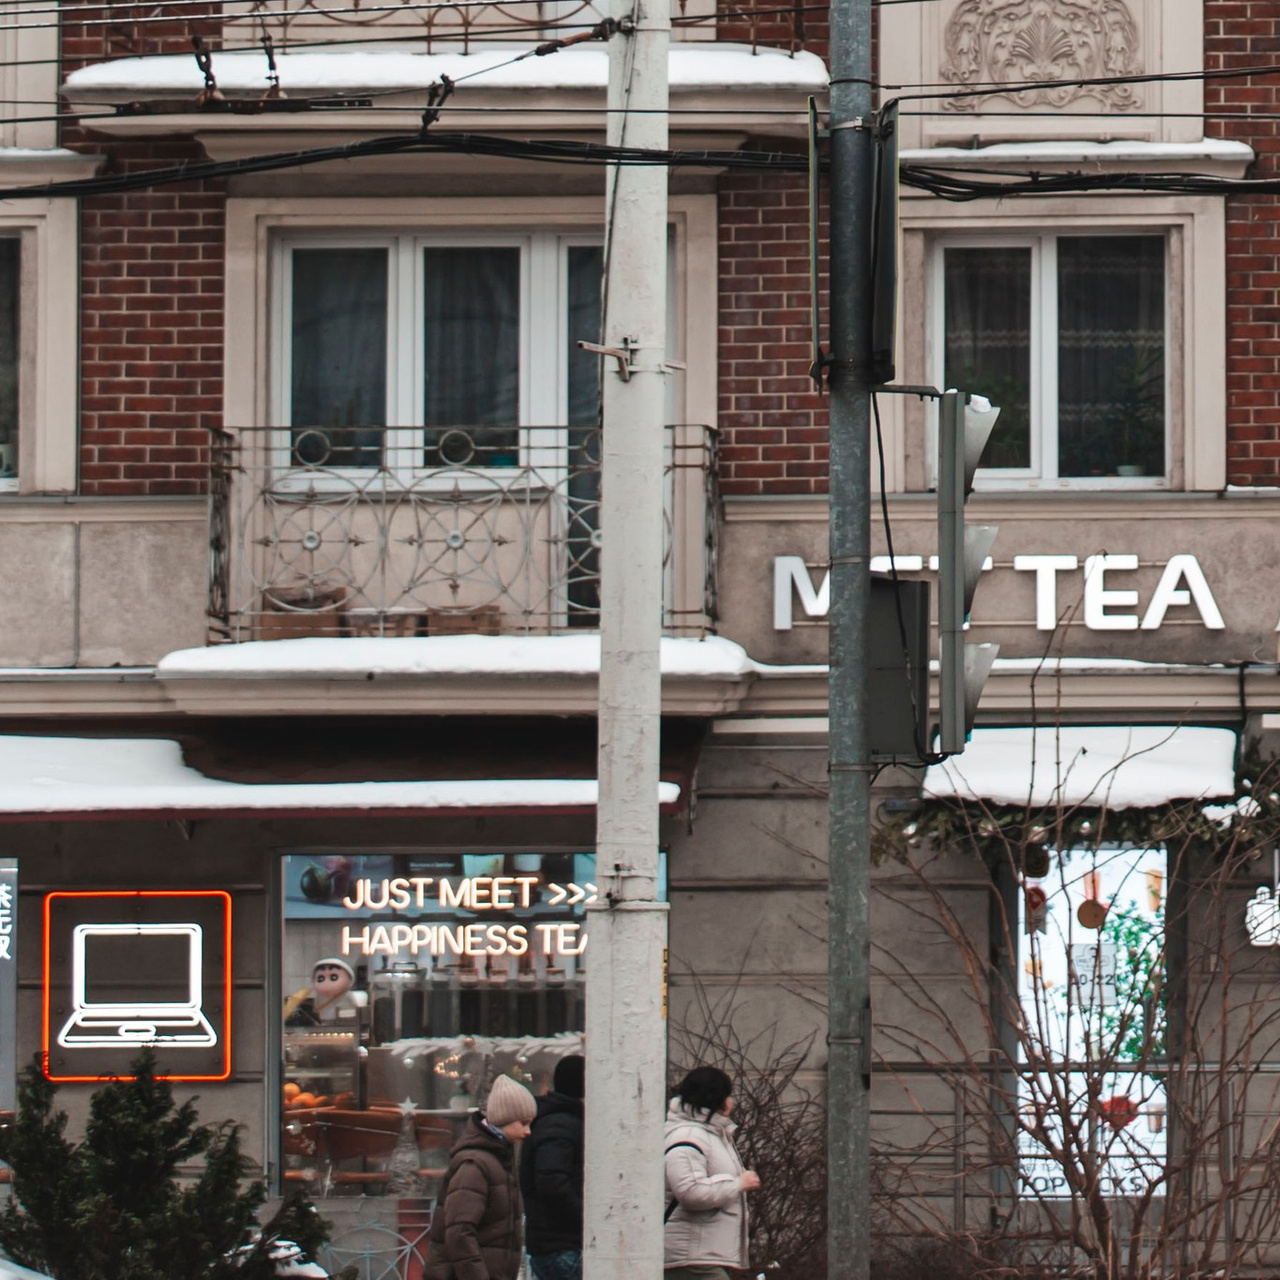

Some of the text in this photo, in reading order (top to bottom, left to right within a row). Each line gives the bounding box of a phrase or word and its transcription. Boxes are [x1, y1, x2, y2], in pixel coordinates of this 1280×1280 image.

[1014, 554, 1226, 630] TEA
[343, 876, 539, 910] JUST MEET
[341, 923, 529, 957] HAPPINESS
